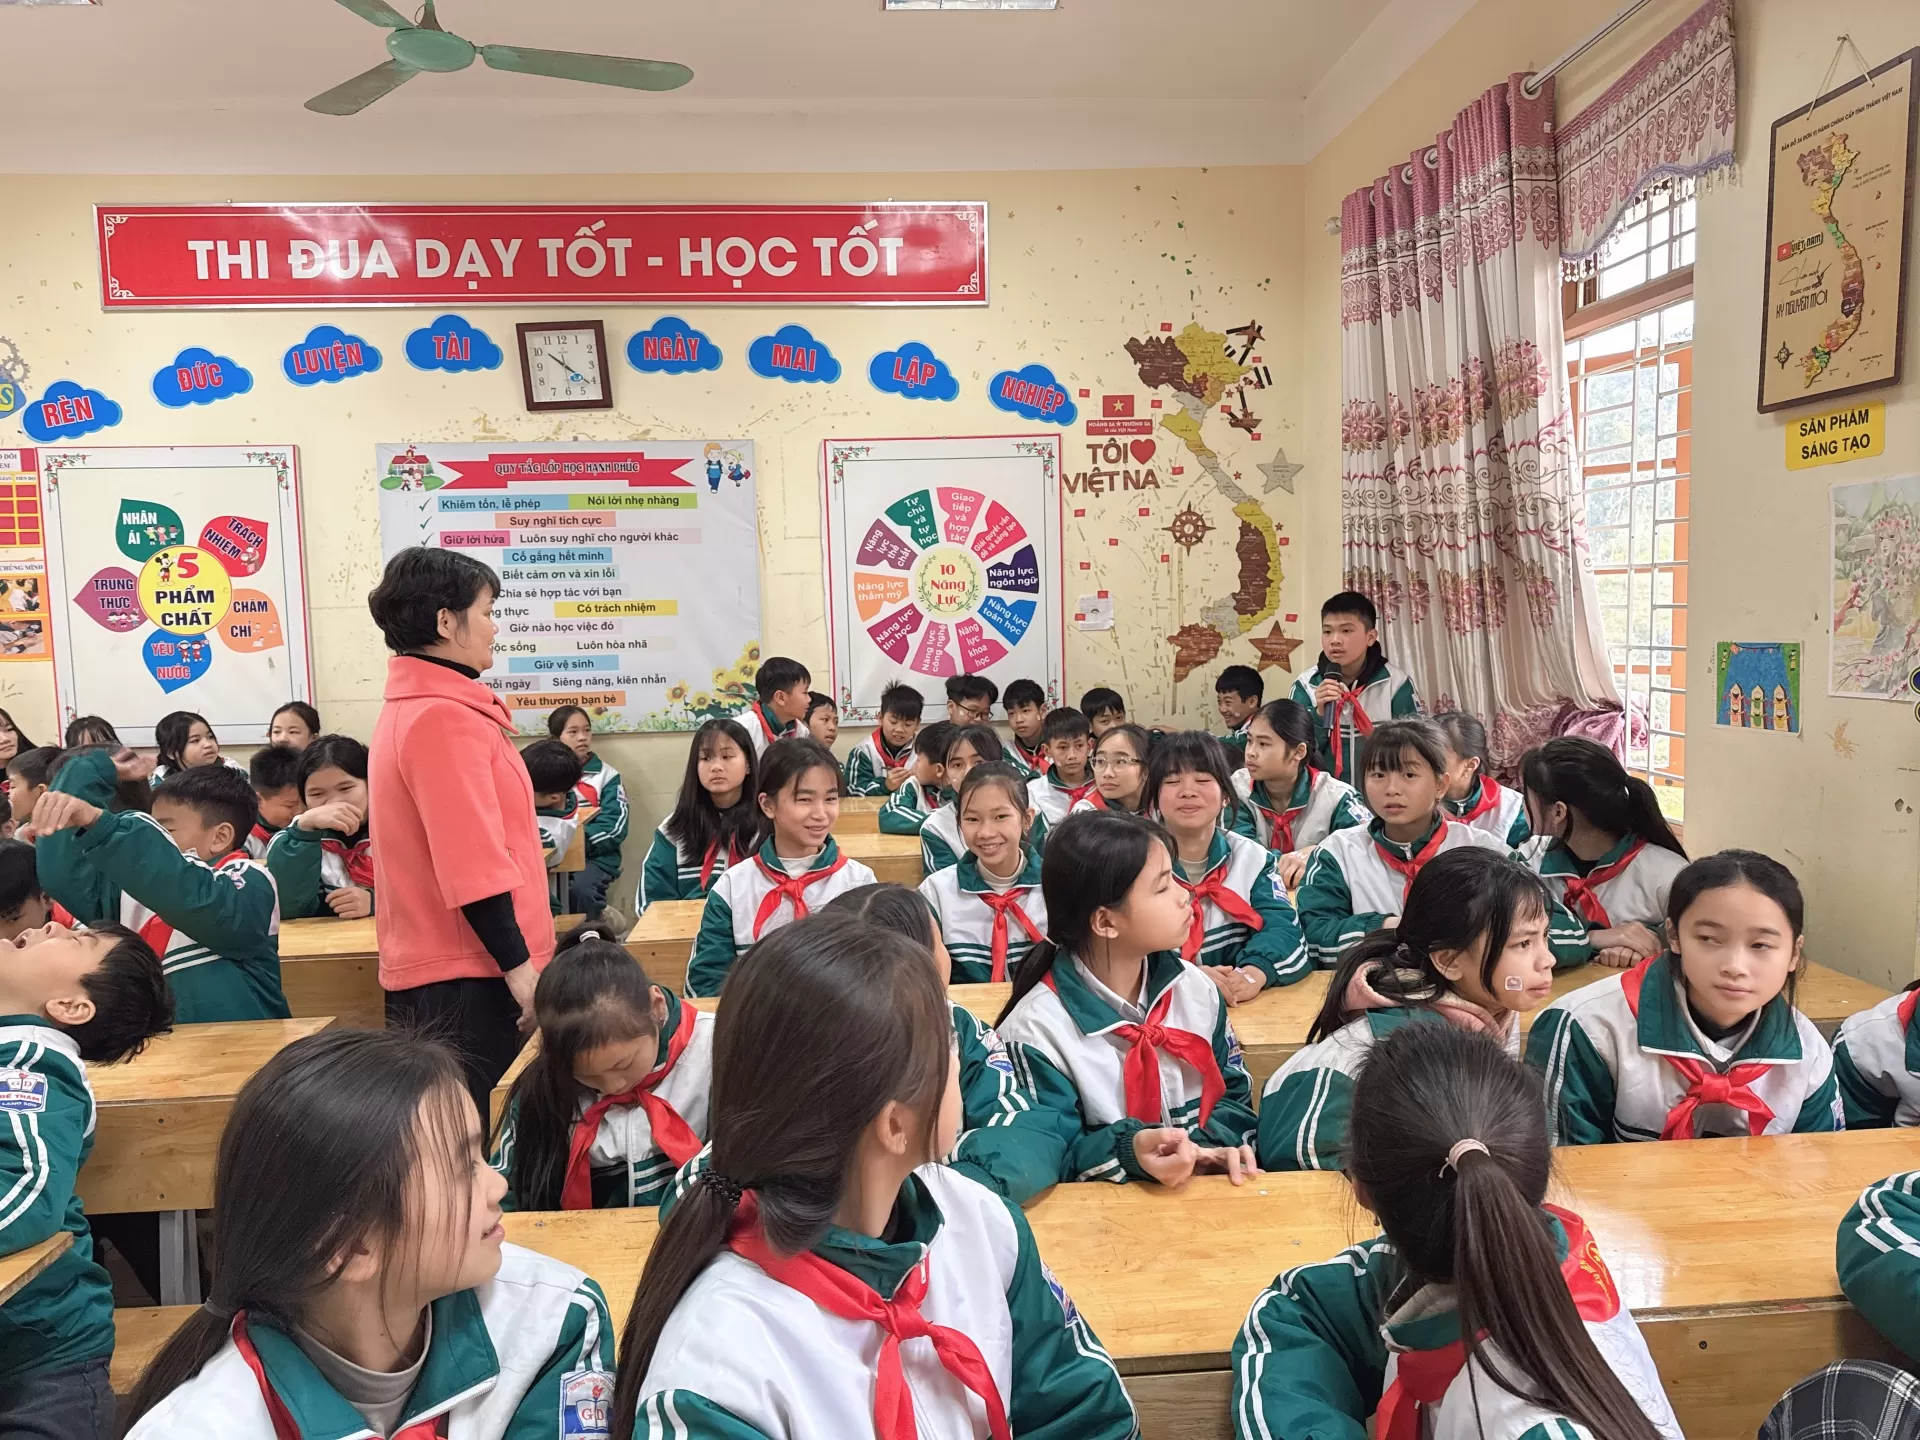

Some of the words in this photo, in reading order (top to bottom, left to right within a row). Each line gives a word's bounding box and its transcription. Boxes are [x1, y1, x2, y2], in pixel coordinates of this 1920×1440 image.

[187, 239, 270, 280] THI
[287, 238, 400, 280] ĐUA
[416, 237, 521, 290] DẠY
[538, 219, 633, 277] TỐT
[647, 256, 663, 267] -
[679, 236, 798, 288] HỌC
[812, 218, 904, 278] TỐT
[543, 335, 552, 345] 11
[557, 335, 568, 345] 12
[533, 347, 543, 357] 10
[586, 344, 593, 353] 2
[536, 362, 543, 371] 9
[588, 360, 595, 369] 3
[41, 394, 94, 429] RÈN
[177, 360, 224, 394] ĐỨC
[292, 341, 364, 377] LUYỆN
[432, 331, 471, 362] TÀI
[643, 333, 700, 364] NGÀY
[771, 343, 817, 373] MAI
[892, 352, 937, 388] LẬP
[1000, 376, 1065, 416] NGHIỆP
[538, 377, 545, 386] 8
[590, 376, 596, 385] 4
[550, 387, 557, 396] 7
[565, 387, 572, 396] 6
[580, 386, 586, 396] 5
[1800, 418, 1826, 437] SẢN
[1830, 408, 1869, 430] PHẨM
[1086, 437, 1128, 465] TÔI
[1802, 441, 1838, 460] SÁNG
[1842, 434, 1870, 454] TẠO
[494, 462, 517, 476] QUY
[518, 458, 540, 474] TẮC
[541, 459, 561, 474] LỚP
[563, 462, 583, 476] HỌC
[585, 462, 612, 476] HẠNH
[613, 458, 640, 473] PHÚC
[1062, 466, 1120, 498] VIỆT
[1123, 468, 1161, 491] NA
[587, 496, 605, 506] Nói
[608, 496, 622, 505] lời
[625, 496, 644, 507] nhẹ
[647, 495, 679, 506] nhàng
[904, 496, 919, 507] Tự
[951, 492, 975, 502] Giao
[442, 499, 476, 509] Khiêm
[478, 498, 499, 510] tốn,
[502, 498, 511, 508] lễ
[514, 499, 541, 510] phép
[952, 502, 972, 514] tiếp
[122, 509, 158, 525] NHÂN
[907, 504, 926, 518] chủ
[510, 516, 530, 527] Suy
[533, 516, 557, 527] nghĩ
[559, 516, 579, 525] tích
[581, 517, 602, 527] cực
[914, 515, 926, 525] và
[955, 514, 967, 522] và
[227, 517, 264, 548] TRÁCH
[918, 525, 930, 535] tự
[949, 522, 970, 533] hợp
[127, 530, 141, 545] ÁI
[203, 528, 242, 559] NHIỆM
[444, 535, 464, 544] Giữ
[467, 535, 481, 544] lời
[484, 534, 505, 544] hứa
[520, 534, 547, 543] Luôn
[550, 535, 568, 544] suy
[572, 534, 595, 544] nghĩ
[598, 533, 617, 542] cho
[620, 532, 651, 543] người
[654, 532, 679, 541] khác
[919, 532, 938, 546] học
[950, 534, 966, 542] tác
[511, 551, 527, 561] Cố
[530, 551, 556, 563] gắng
[559, 550, 575, 561] hết
[176, 552, 200, 579] 5
[940, 564, 956, 576] 10
[502, 569, 524, 580] Biết
[526, 569, 548, 579] cảm
[551, 570, 565, 578] ơn
[568, 569, 581, 578] và
[584, 569, 600, 578] xin
[602, 567, 615, 578] lỗi
[989, 568, 1015, 578] Năng
[1018, 567, 1034, 576] lực
[94, 578, 134, 591] TRUNG
[930, 580, 966, 592] Năng
[990, 578, 1015, 588] ngôn
[1018, 576, 1038, 586] ngữ
[155, 584, 215, 605] PHẨM
[498, 588, 522, 598] Chia
[540, 588, 562, 599] hợp
[564, 588, 580, 597] tác
[583, 587, 600, 597] với
[602, 587, 622, 597] bạn
[100, 596, 131, 611] THỰC
[233, 599, 268, 613] CHĂM
[937, 594, 960, 606] Lực
[504, 607, 529, 617] thực
[577, 603, 592, 613] Có
[594, 603, 621, 613] trách
[624, 602, 656, 613] nhiệm
[988, 598, 1012, 619] Năng
[1012, 614, 1029, 628] lực
[161, 607, 213, 626] CHẤT
[982, 607, 1003, 624] toán
[1004, 620, 1022, 636] học
[230, 621, 252, 638] CHỈ
[509, 622, 529, 633] Giờ
[532, 622, 552, 632] nào
[554, 622, 574, 633] học
[576, 622, 598, 632] việc
[601, 622, 614, 631] đó
[151, 640, 175, 656] YÊU
[510, 640, 536, 653] sống
[577, 640, 603, 650] Luôn
[606, 639, 625, 649] hòa
[628, 640, 648, 649] nhã
[157, 663, 191, 679] NƯỚC
[534, 660, 554, 670] Giữ
[557, 660, 568, 671] vệ
[572, 659, 594, 669] sinh
[505, 679, 531, 691] ngày
[552, 676, 583, 688] Siêng
[585, 676, 614, 688] năng,
[617, 675, 638, 685] kiên
[641, 674, 667, 685] nhẫn
[516, 696, 536, 706] Yêu
[539, 696, 578, 707] thương
[581, 695, 601, 706] bạn
[604, 695, 616, 704] bè
